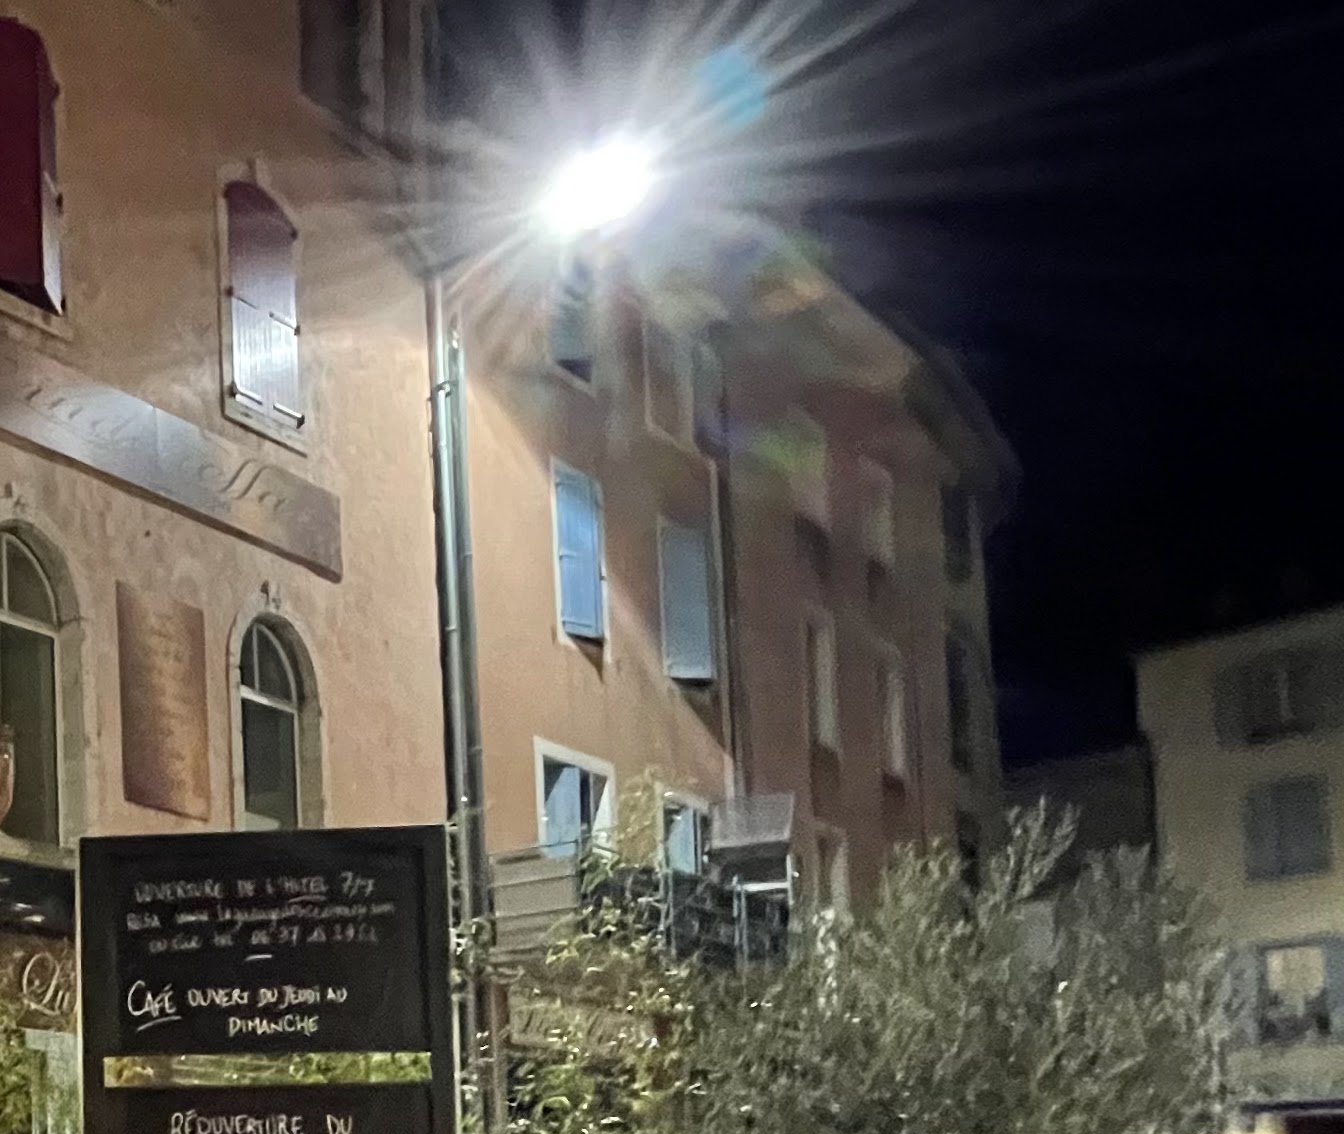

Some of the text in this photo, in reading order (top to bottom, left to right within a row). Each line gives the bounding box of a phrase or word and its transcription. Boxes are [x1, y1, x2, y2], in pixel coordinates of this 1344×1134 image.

[187, 987, 249, 1008] OUVERT
[256, 987, 278, 1008] DU
[326, 986, 349, 1004] AU
[227, 1014, 320, 1038] DIMANCHE
